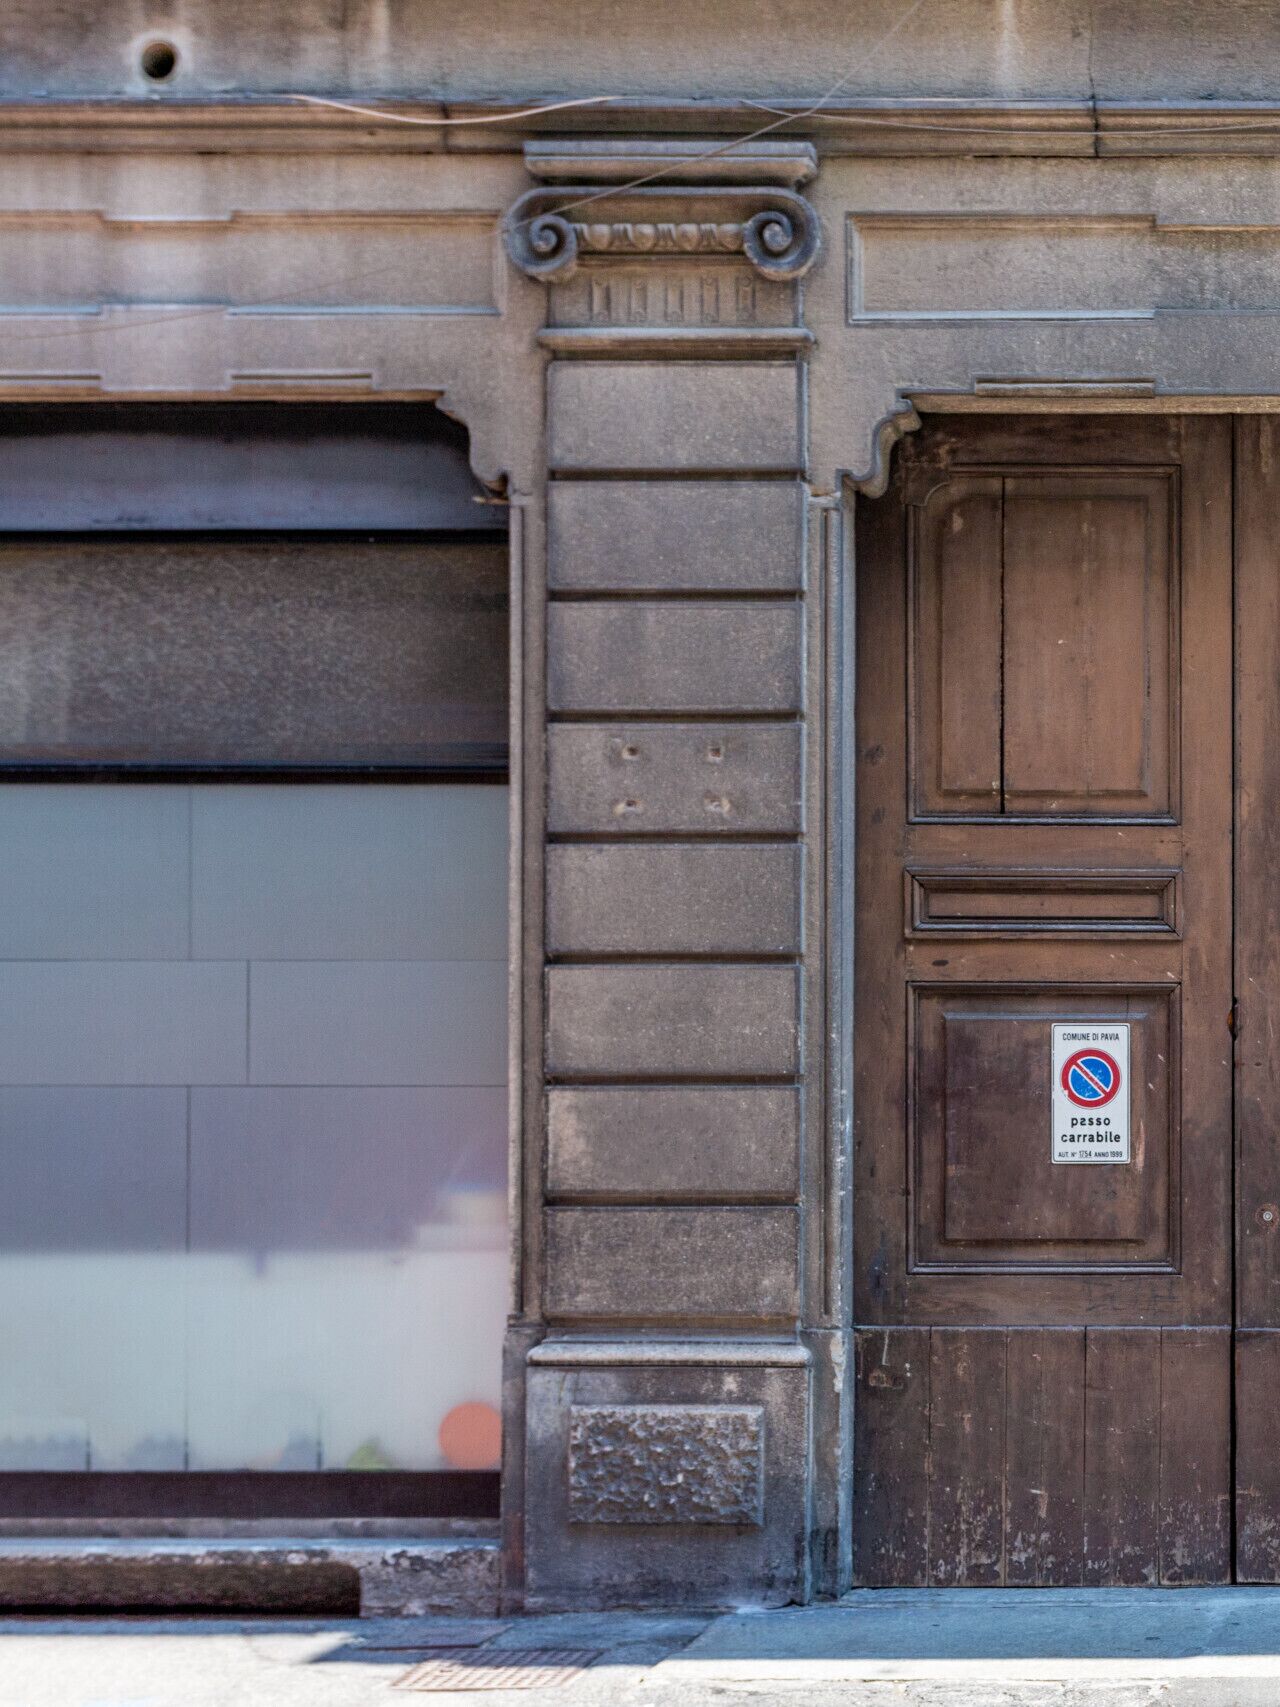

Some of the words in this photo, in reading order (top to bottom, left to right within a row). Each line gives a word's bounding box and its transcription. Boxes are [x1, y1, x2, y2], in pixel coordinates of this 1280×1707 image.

[1062, 1032, 1090, 1041] COMUNE
[1092, 1032, 1099, 1041] DI
[1100, 1032, 1120, 1041] PAVIA
[1070, 1117, 1111, 1128] passo
[1060, 1131, 1121, 1143] carrabile
